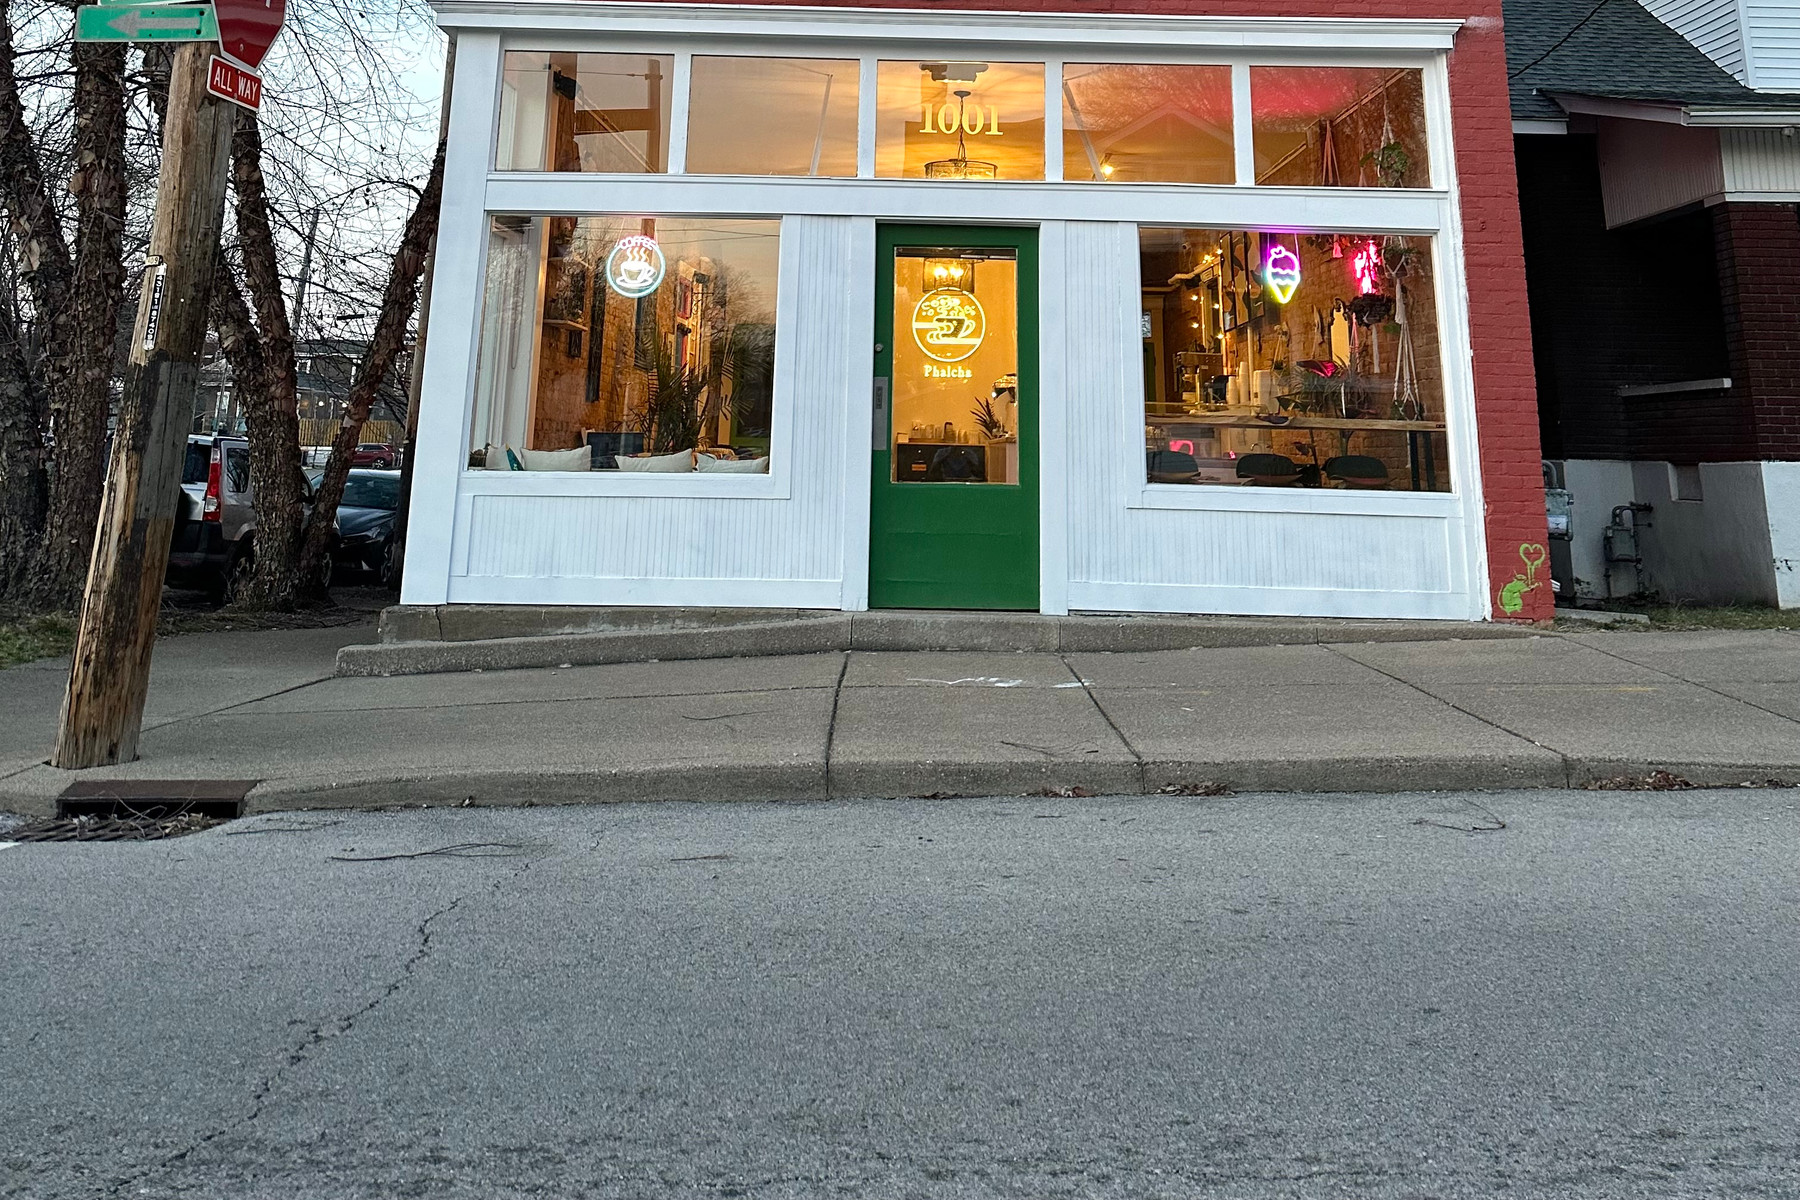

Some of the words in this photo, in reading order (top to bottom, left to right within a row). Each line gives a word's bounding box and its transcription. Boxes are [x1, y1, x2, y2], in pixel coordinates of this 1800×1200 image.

[213, 65, 233, 92] ALL
[237, 75, 259, 102] WAY
[918, 102, 1004, 136] 1001
[619, 235, 656, 251] COFFEE
[923, 364, 973, 378] Phalcha
